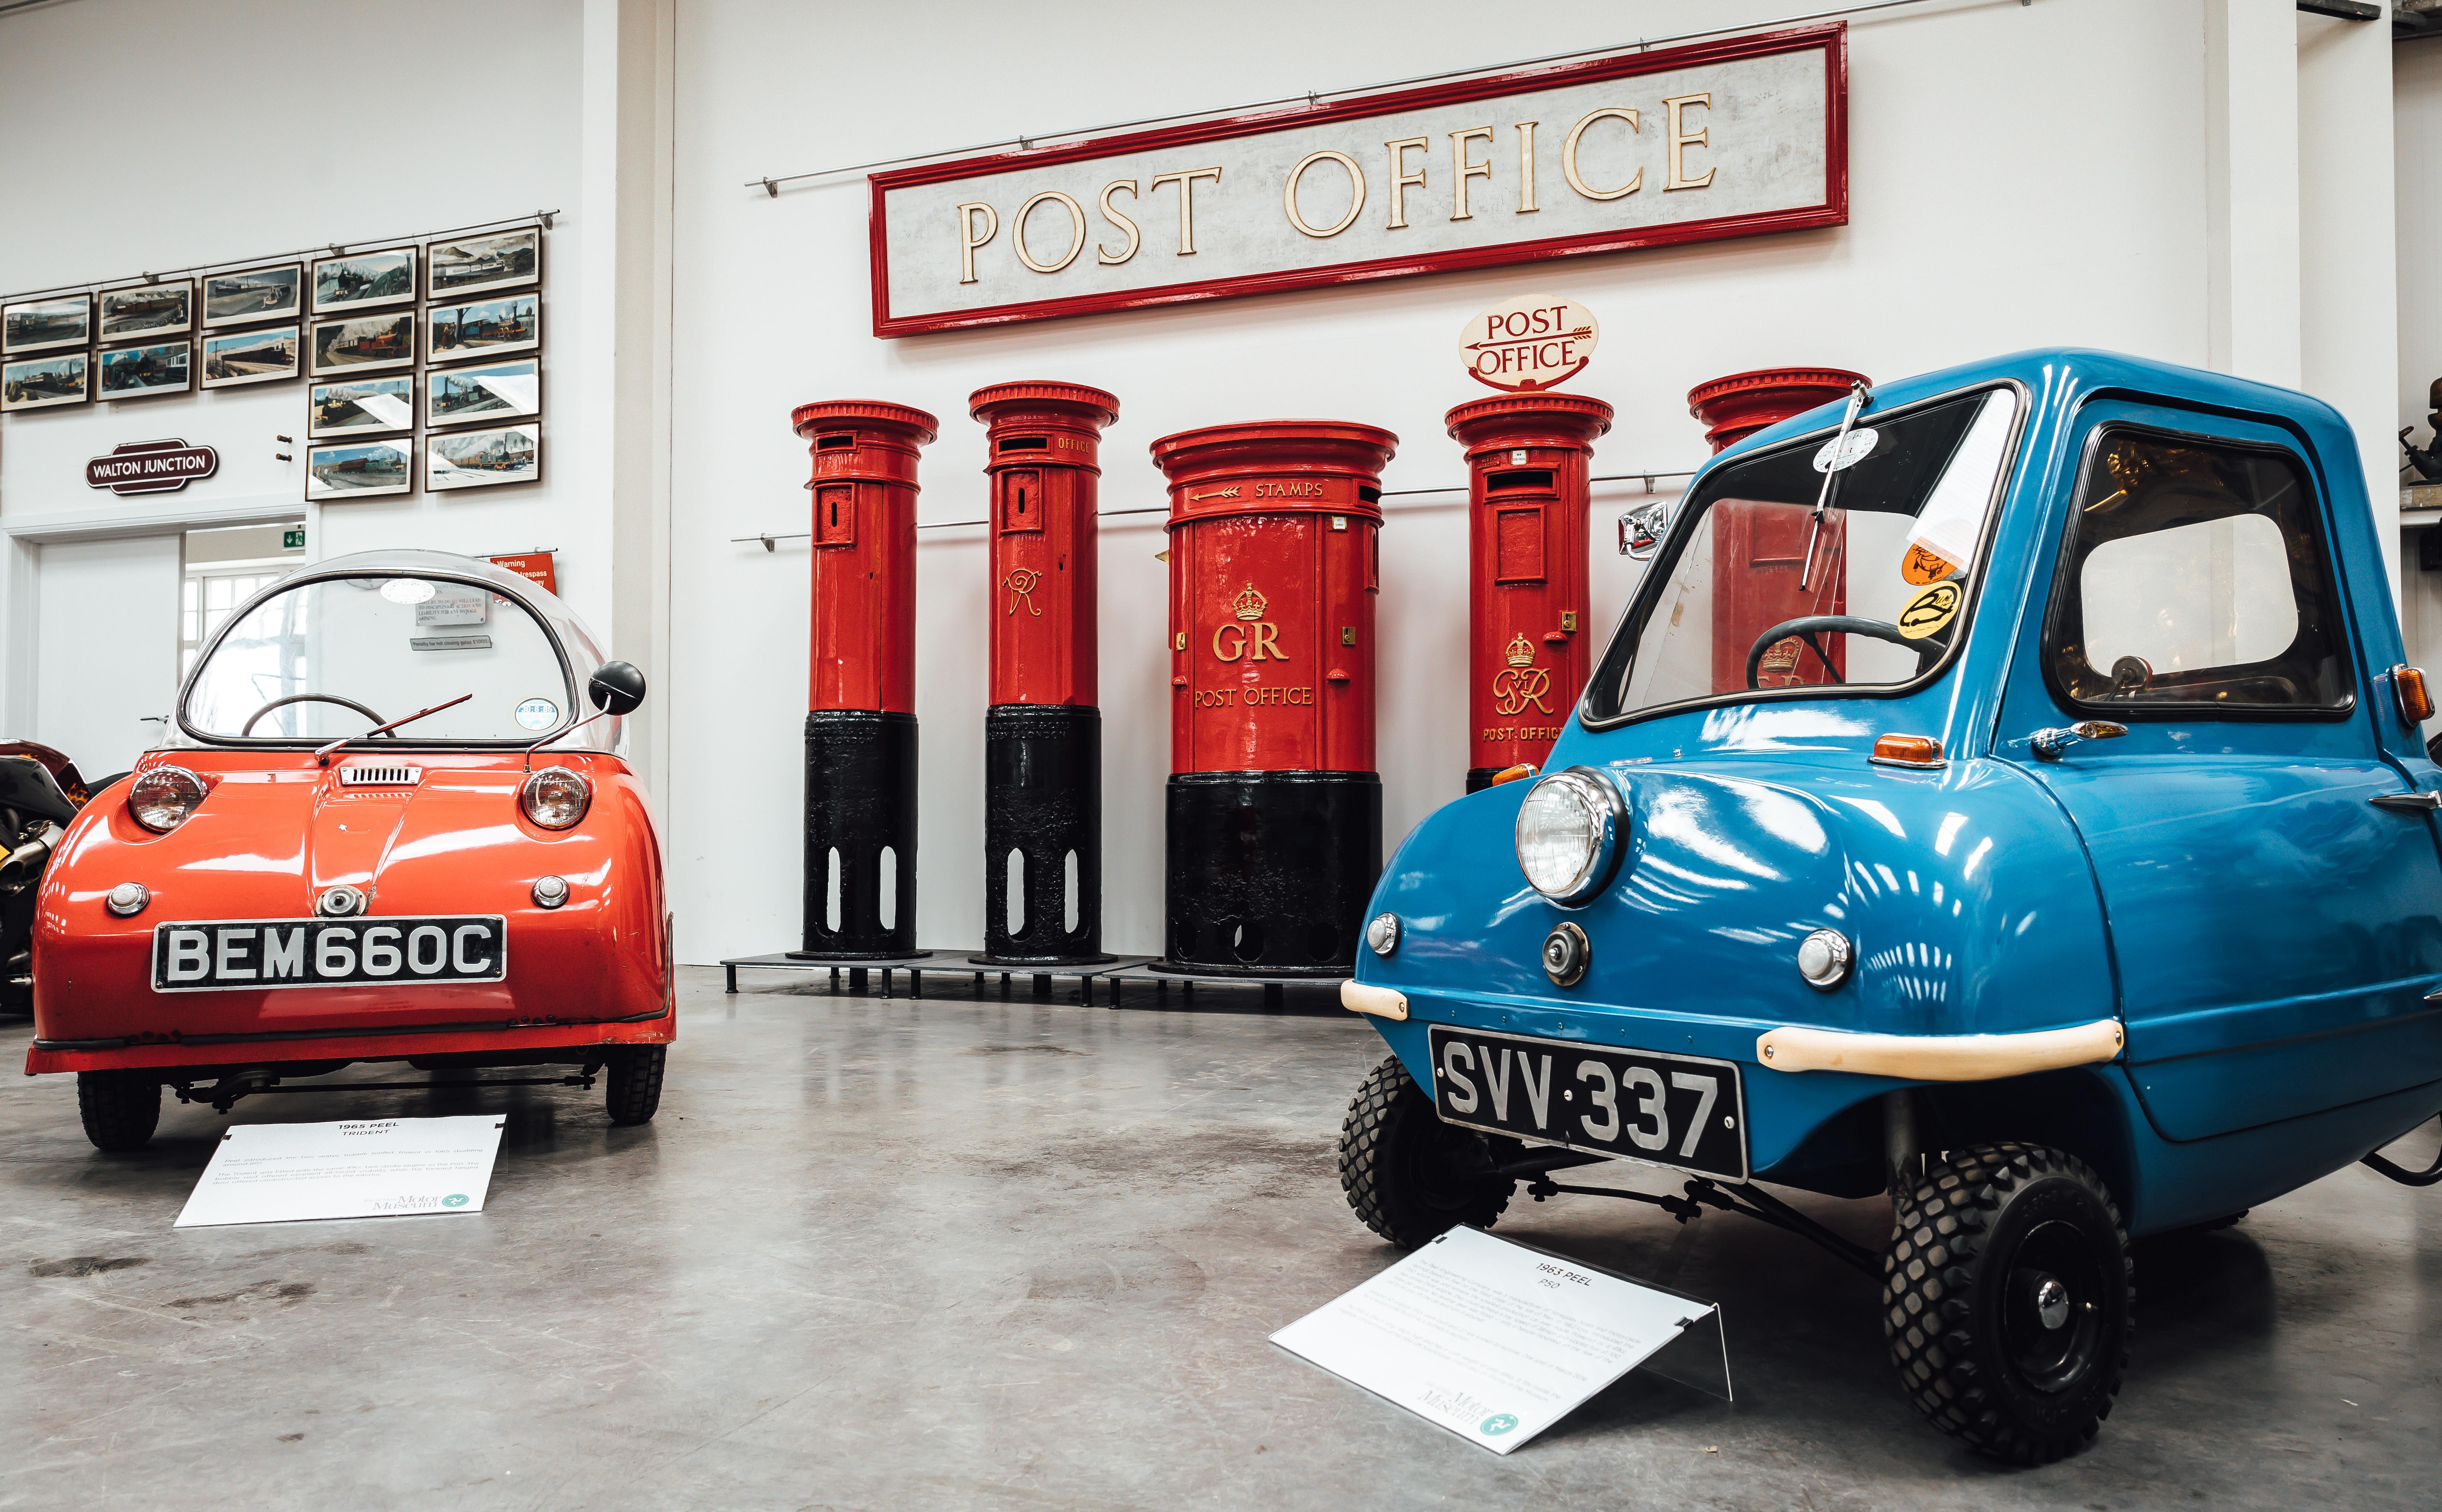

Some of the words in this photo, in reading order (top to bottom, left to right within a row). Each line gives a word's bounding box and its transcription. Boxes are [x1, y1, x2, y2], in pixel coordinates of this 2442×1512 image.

[957, 165, 1222, 284] POST
[1283, 91, 1716, 238] OFFICE
[1487, 306, 1568, 339] POST
[1477, 340, 1577, 374] OFFICE
[1058, 438, 1089, 453] OFFICE
[94, 460, 141, 478] WALTON
[144, 455, 205, 474] JUNCTION
[1256, 482, 1323, 498] STAMPS
[1213, 622, 1289, 662] GR
[1195, 689, 1237, 708] POST
[1244, 687, 1312, 706] OFFICE
[1483, 727, 1515, 741] POST
[1521, 726, 1563, 741] OFFIC
[168, 925, 491, 981] BEM660C
[1444, 1042, 1551, 1129] SVV
[1576, 1061, 1717, 1158] 337
[372, 1199, 438, 1210] Museum
[397, 1194, 442, 1203] Motor
[1535, 1263, 1564, 1276] 1963
[1561, 1272, 1596, 1286] PEEL
[1537, 1278, 1562, 1289] P50
[1419, 1391, 1482, 1424] Museum
[1450, 1393, 1496, 1417] Motor
